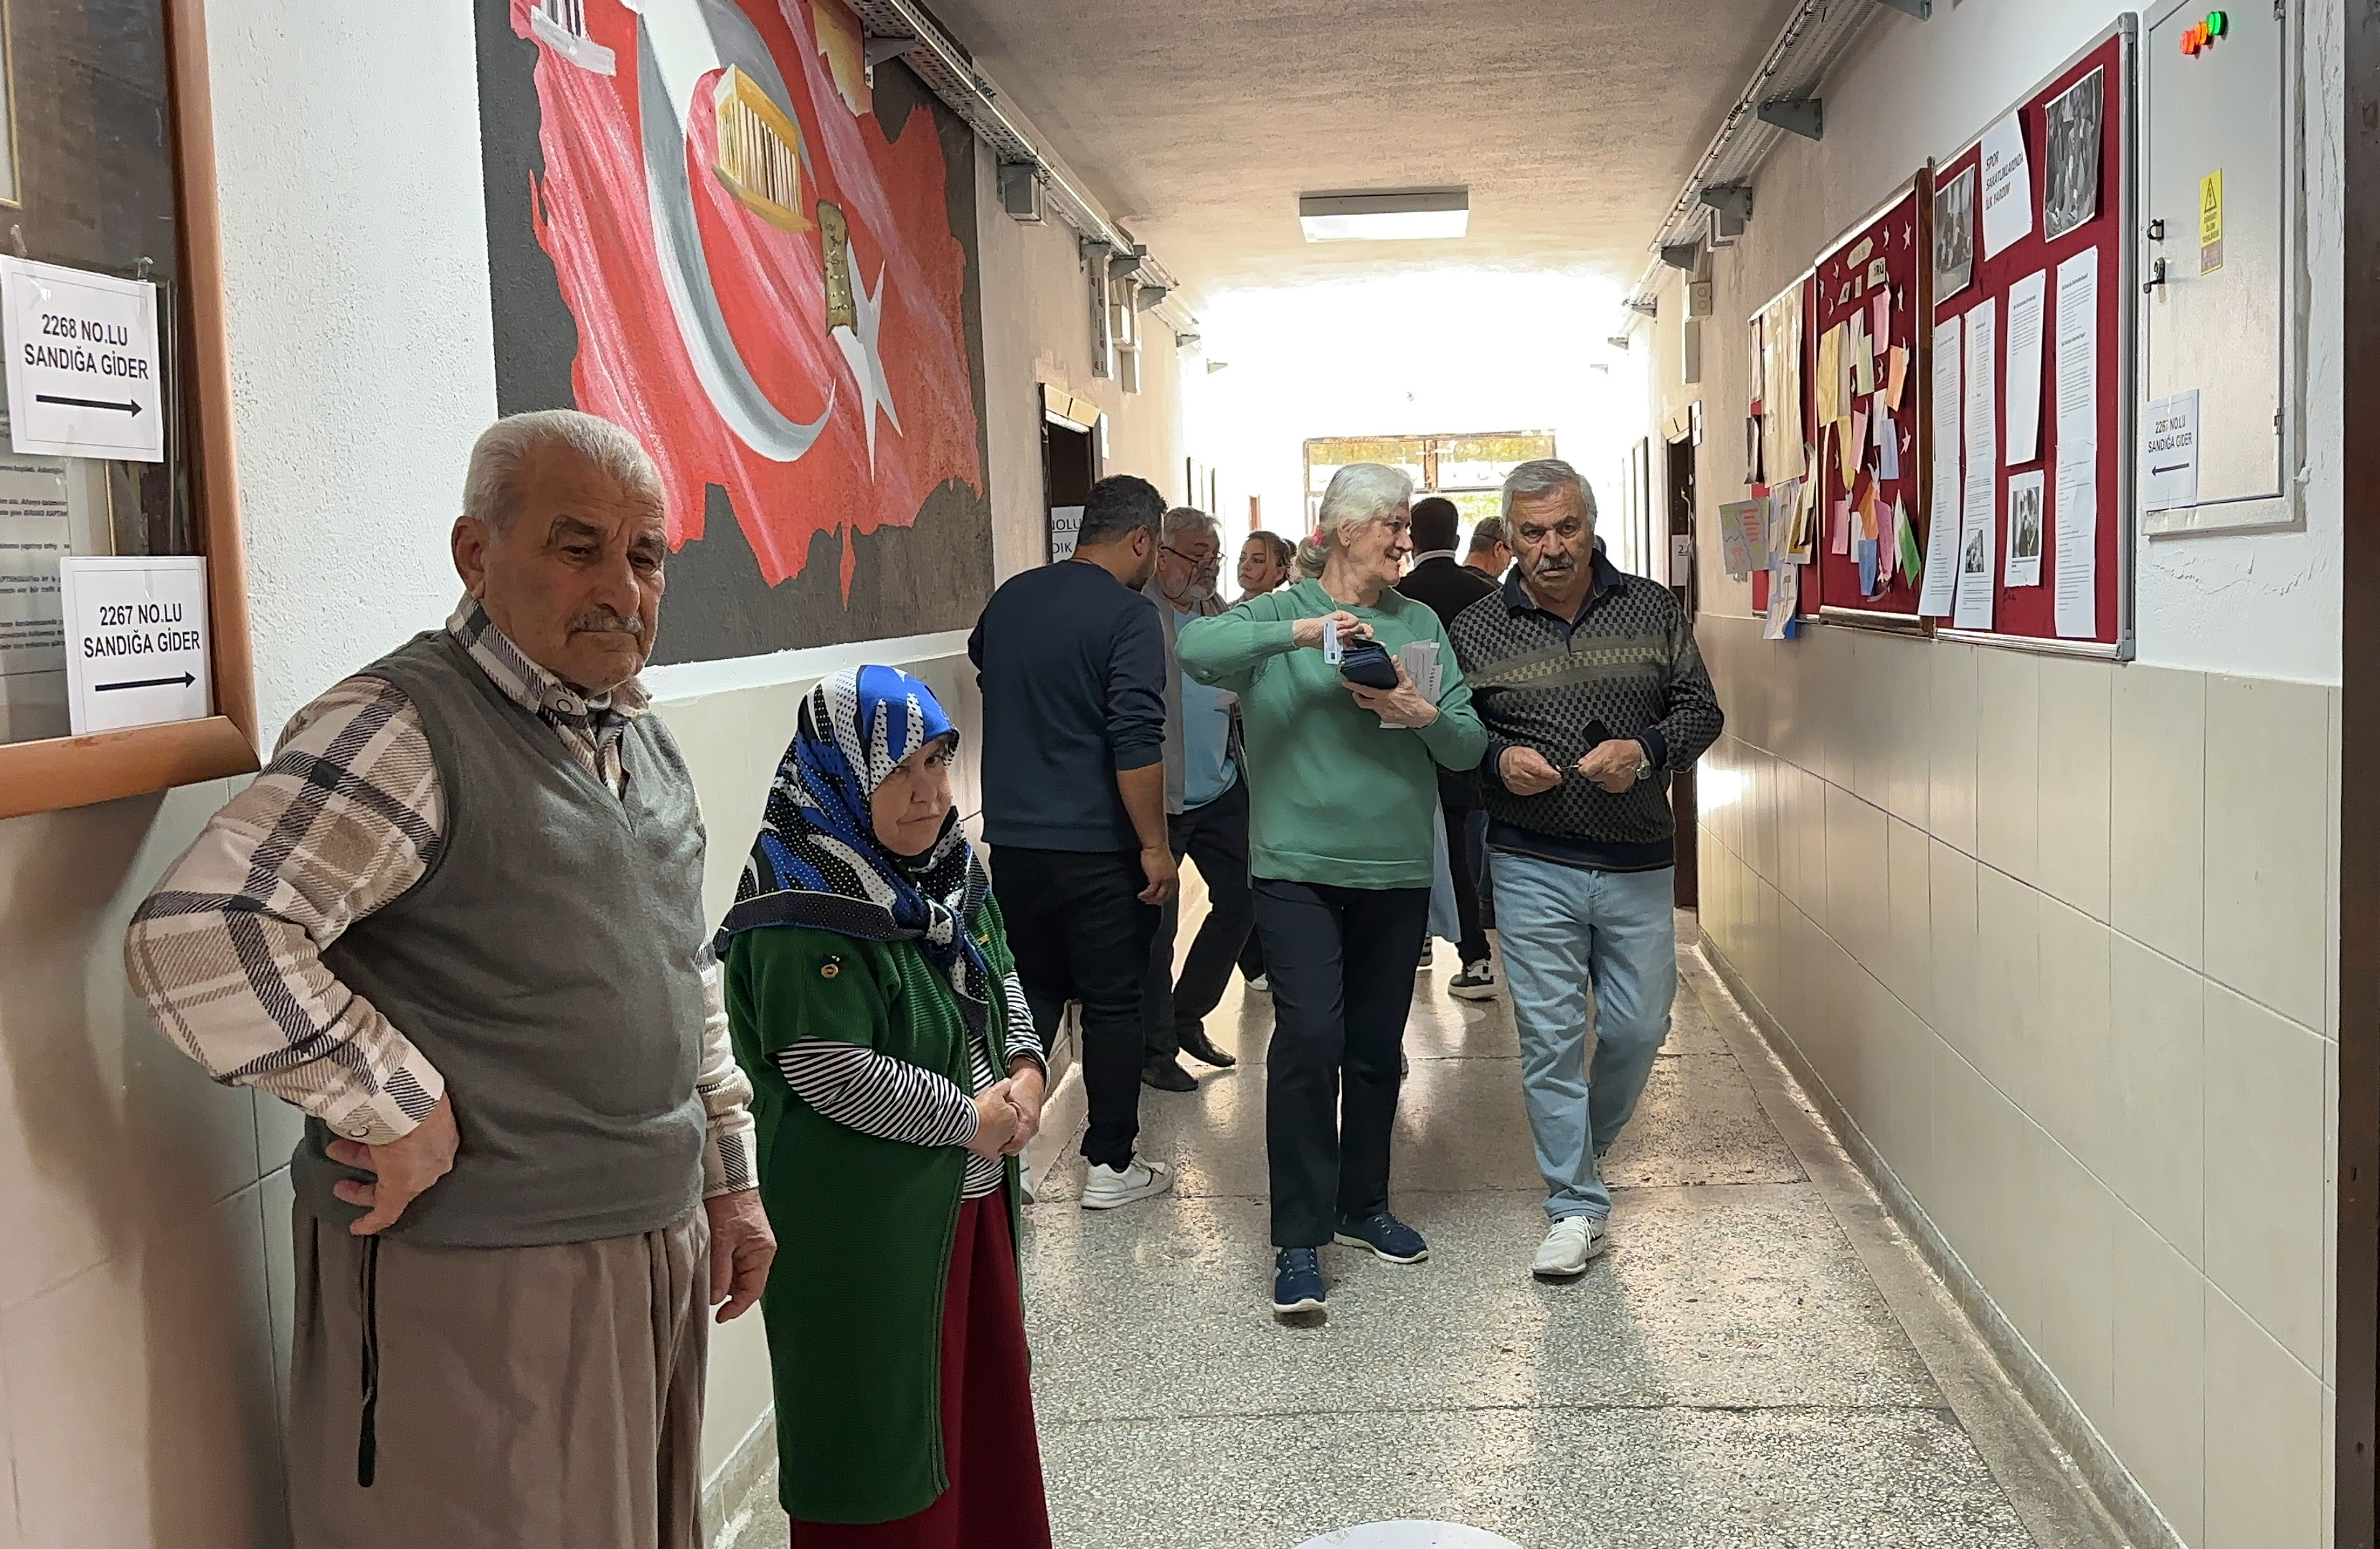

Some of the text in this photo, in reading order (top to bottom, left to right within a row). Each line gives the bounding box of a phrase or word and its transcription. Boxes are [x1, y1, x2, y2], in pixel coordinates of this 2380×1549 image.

[42, 313, 128, 346] 2268 NO.LU
[24, 344, 149, 380] SANDIĞA GİDER
[100, 602, 183, 627] 2267 NO.LU
[84, 629, 154, 658] SANDIĞA
[158, 627, 201, 653] GİDER
